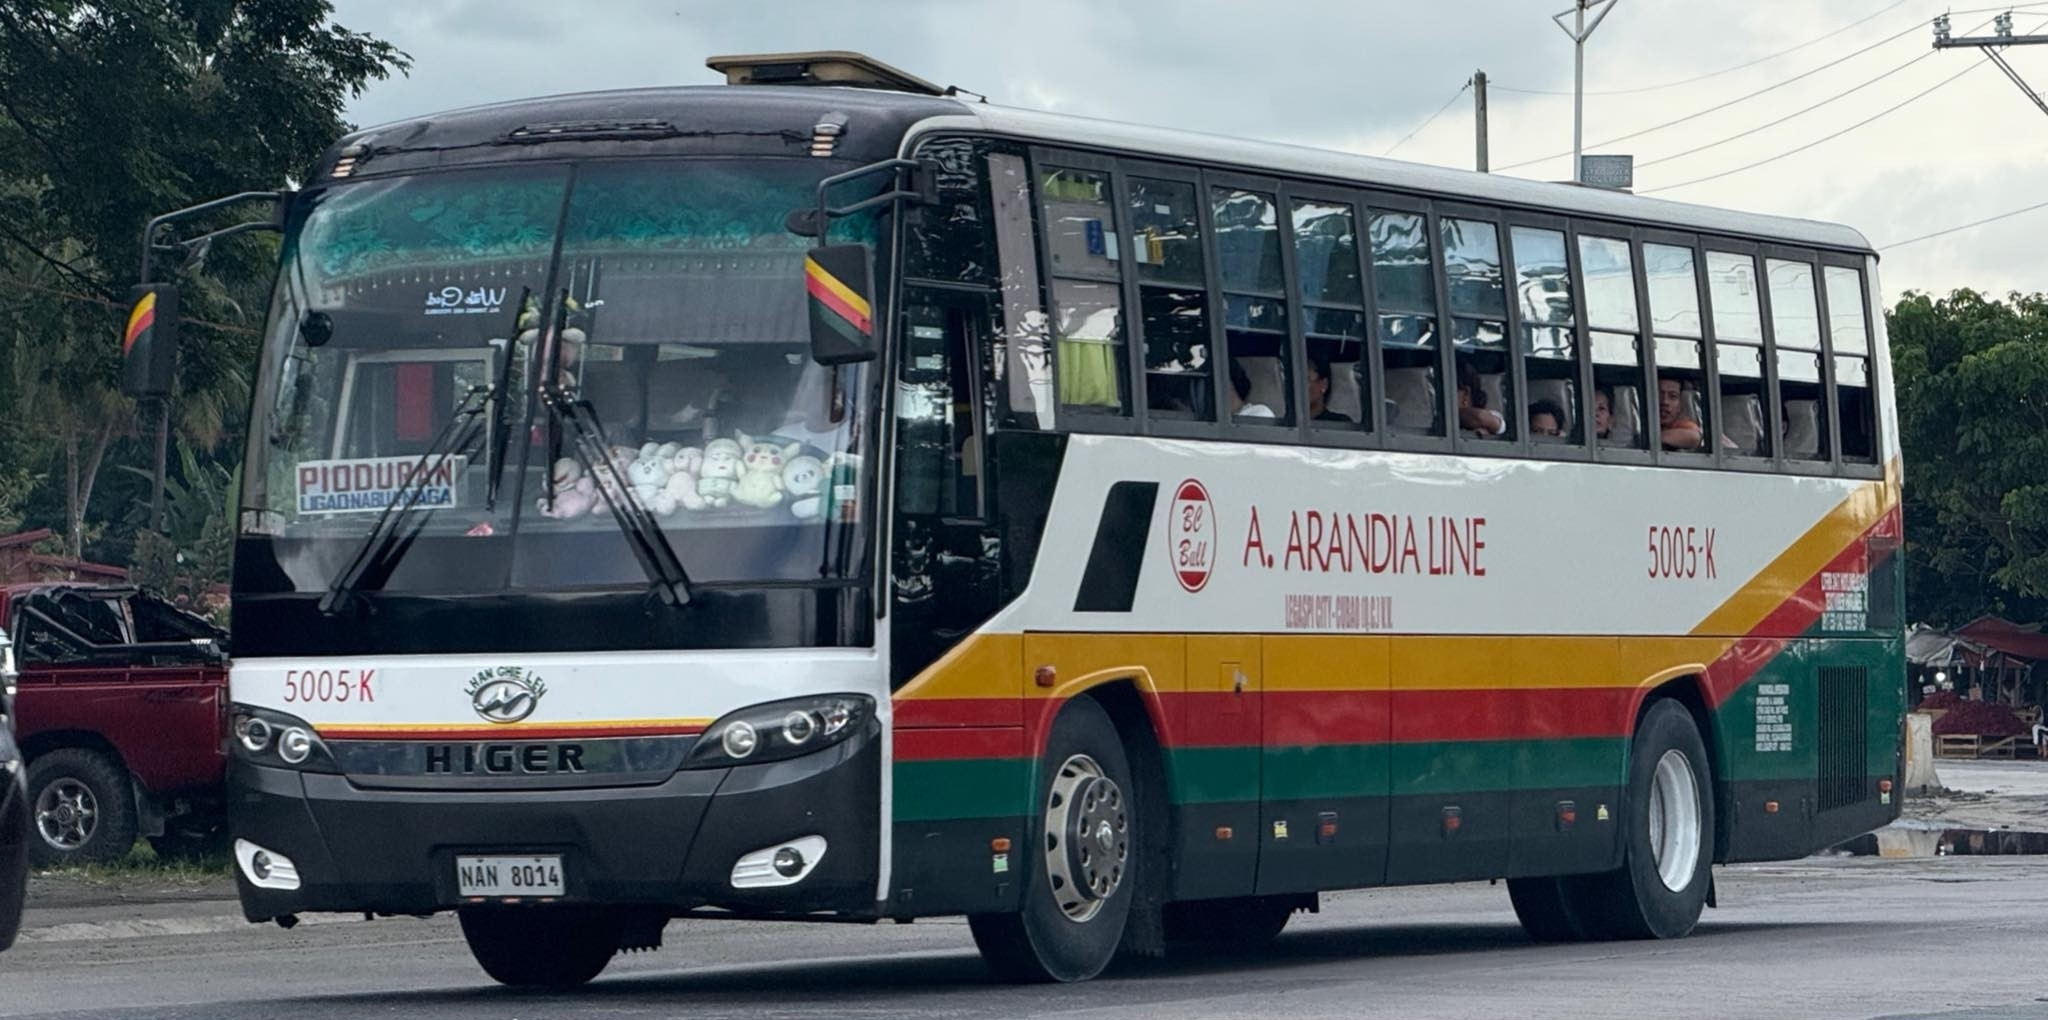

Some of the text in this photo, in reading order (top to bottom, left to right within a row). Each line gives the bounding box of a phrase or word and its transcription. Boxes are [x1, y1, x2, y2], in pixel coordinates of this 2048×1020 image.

[1182, 504, 1204, 533] BC
[1243, 505, 1486, 576] A. ARANDIA LINE
[1647, 525, 1717, 580] 5005-K
[283, 670, 375, 703] 5005-K
[425, 744, 586, 774] HIGER
[461, 865, 560, 888] NAN 8014
